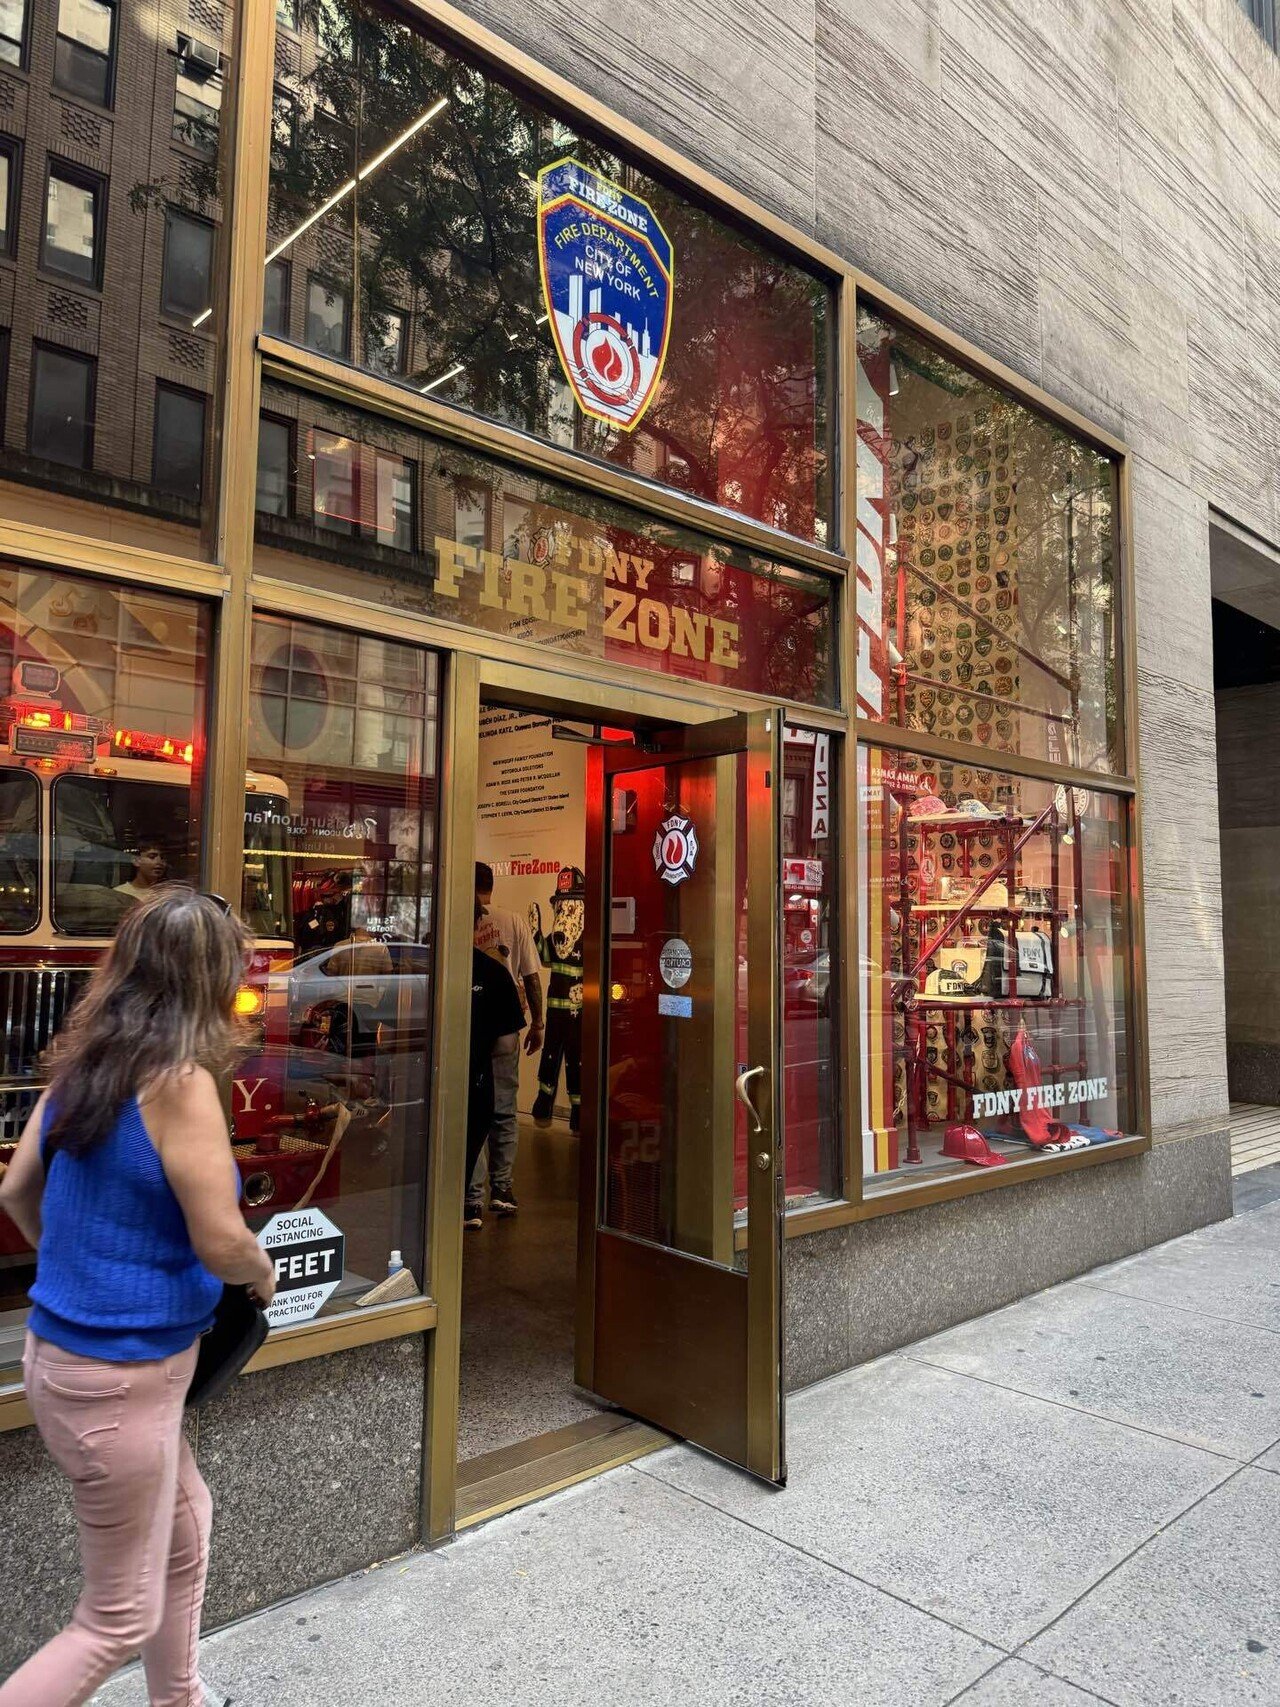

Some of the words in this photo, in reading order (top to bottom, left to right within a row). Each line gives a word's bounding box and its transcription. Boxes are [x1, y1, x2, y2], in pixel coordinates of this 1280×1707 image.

[568, 175, 608, 210] FIRE
[606, 198, 648, 233] ZONE
[554, 223, 581, 250] FIRE
[581, 222, 659, 298] DEPARTMENT
[585, 245, 614, 268] CITY
[615, 261, 632, 277] OF
[575, 256, 604, 283] NEW
[606, 272, 641, 301] YORK
[555, 533, 654, 591] FDNY
[434, 536, 588, 630] FIRE
[603, 586, 739, 669] ZONE
[666, 819, 683, 829] FDNY
[1022, 947, 1041, 959] FDNY
[972, 1088, 1023, 1120] FDNY
[1026, 1083, 1065, 1111] FIRE
[1068, 1077, 1108, 1105] ZONE
[265, 1227, 324, 1245] DISTANCING
[276, 1216, 314, 1231] SOCIAL
[274, 1248, 336, 1282] FEET
[267, 1302, 316, 1319] PRACTICING
[289, 1293, 306, 1304] YOU
[307, 1290, 324, 1301] FOR
